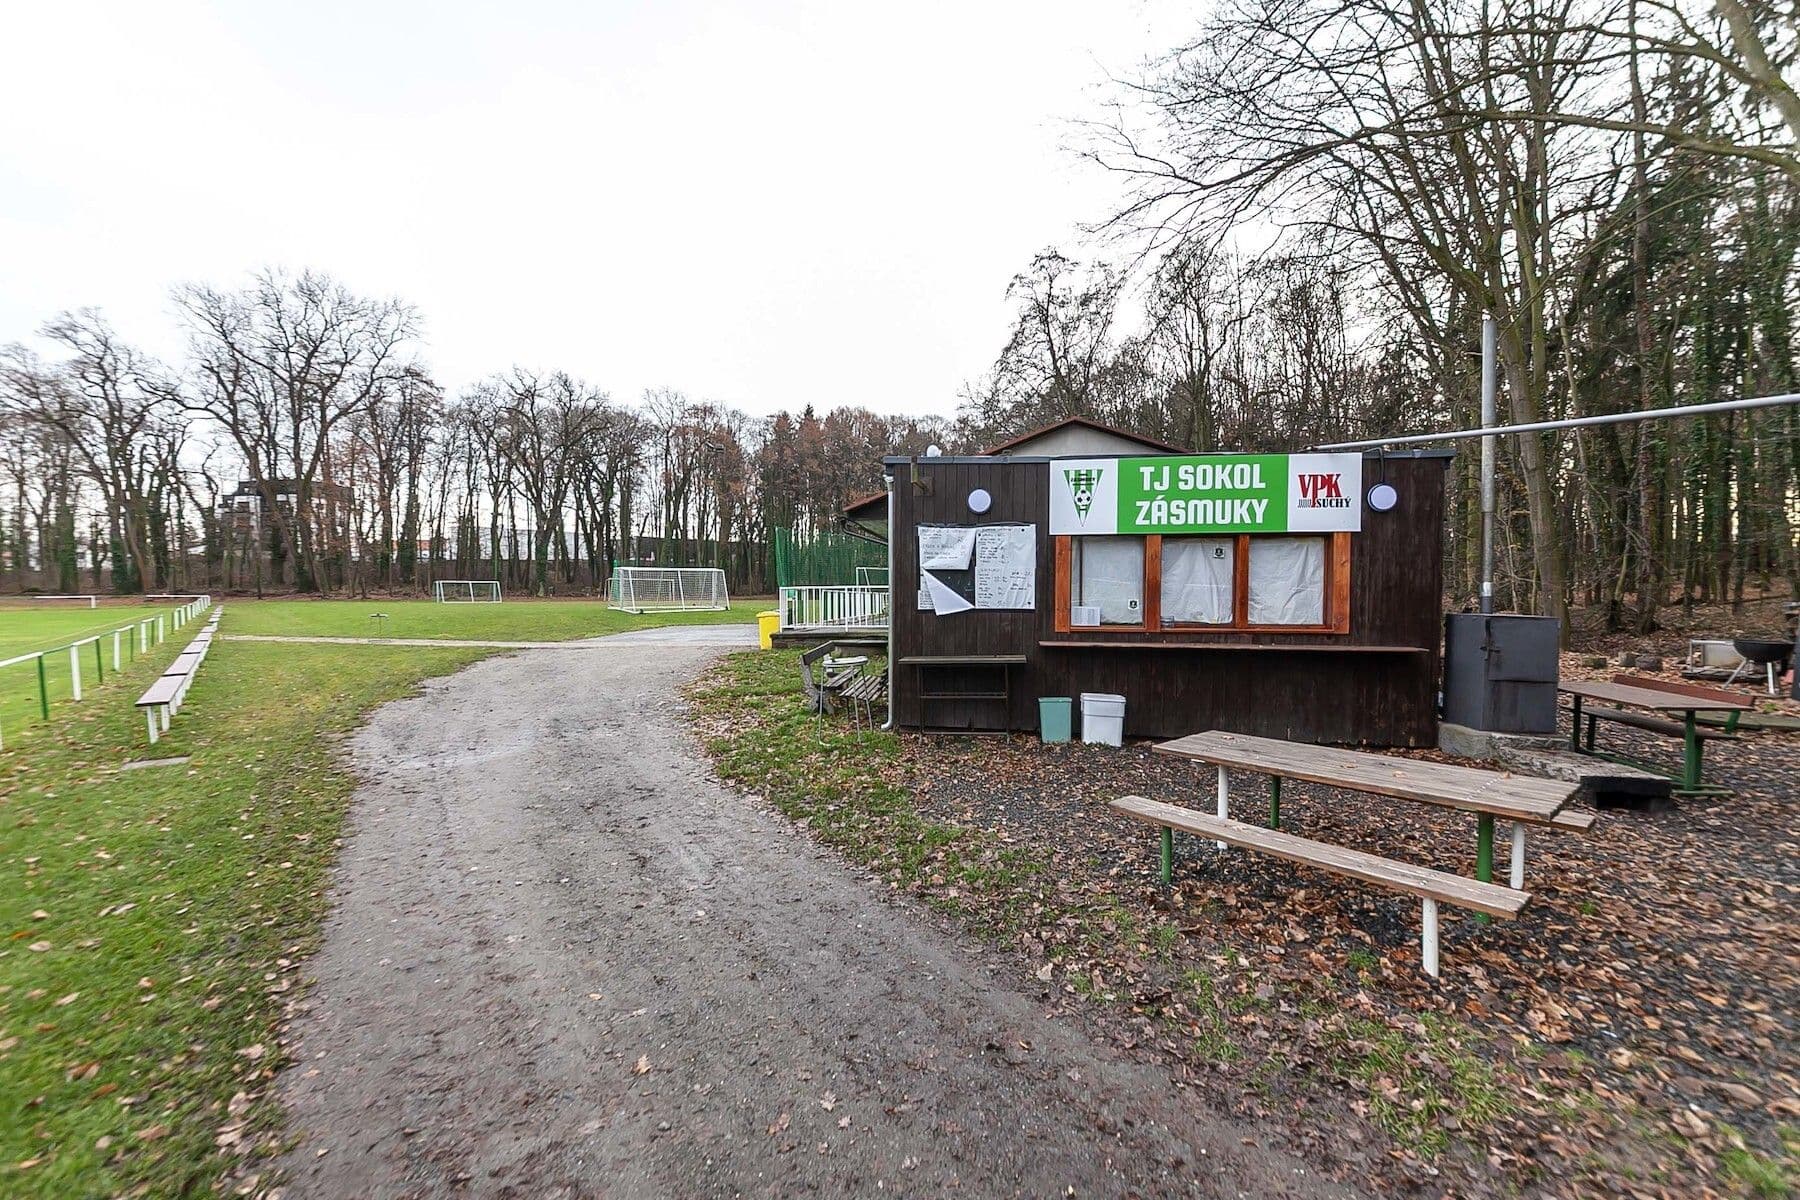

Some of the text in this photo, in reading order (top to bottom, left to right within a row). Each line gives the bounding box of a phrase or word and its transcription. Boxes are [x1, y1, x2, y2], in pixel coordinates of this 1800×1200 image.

[1139, 463, 1266, 491] TJ SOKOL
[1298, 473, 1342, 508] VPK
[1135, 494, 1269, 526] ZÁSMUKY
[1317, 496, 1352, 508] SUCHÝ
